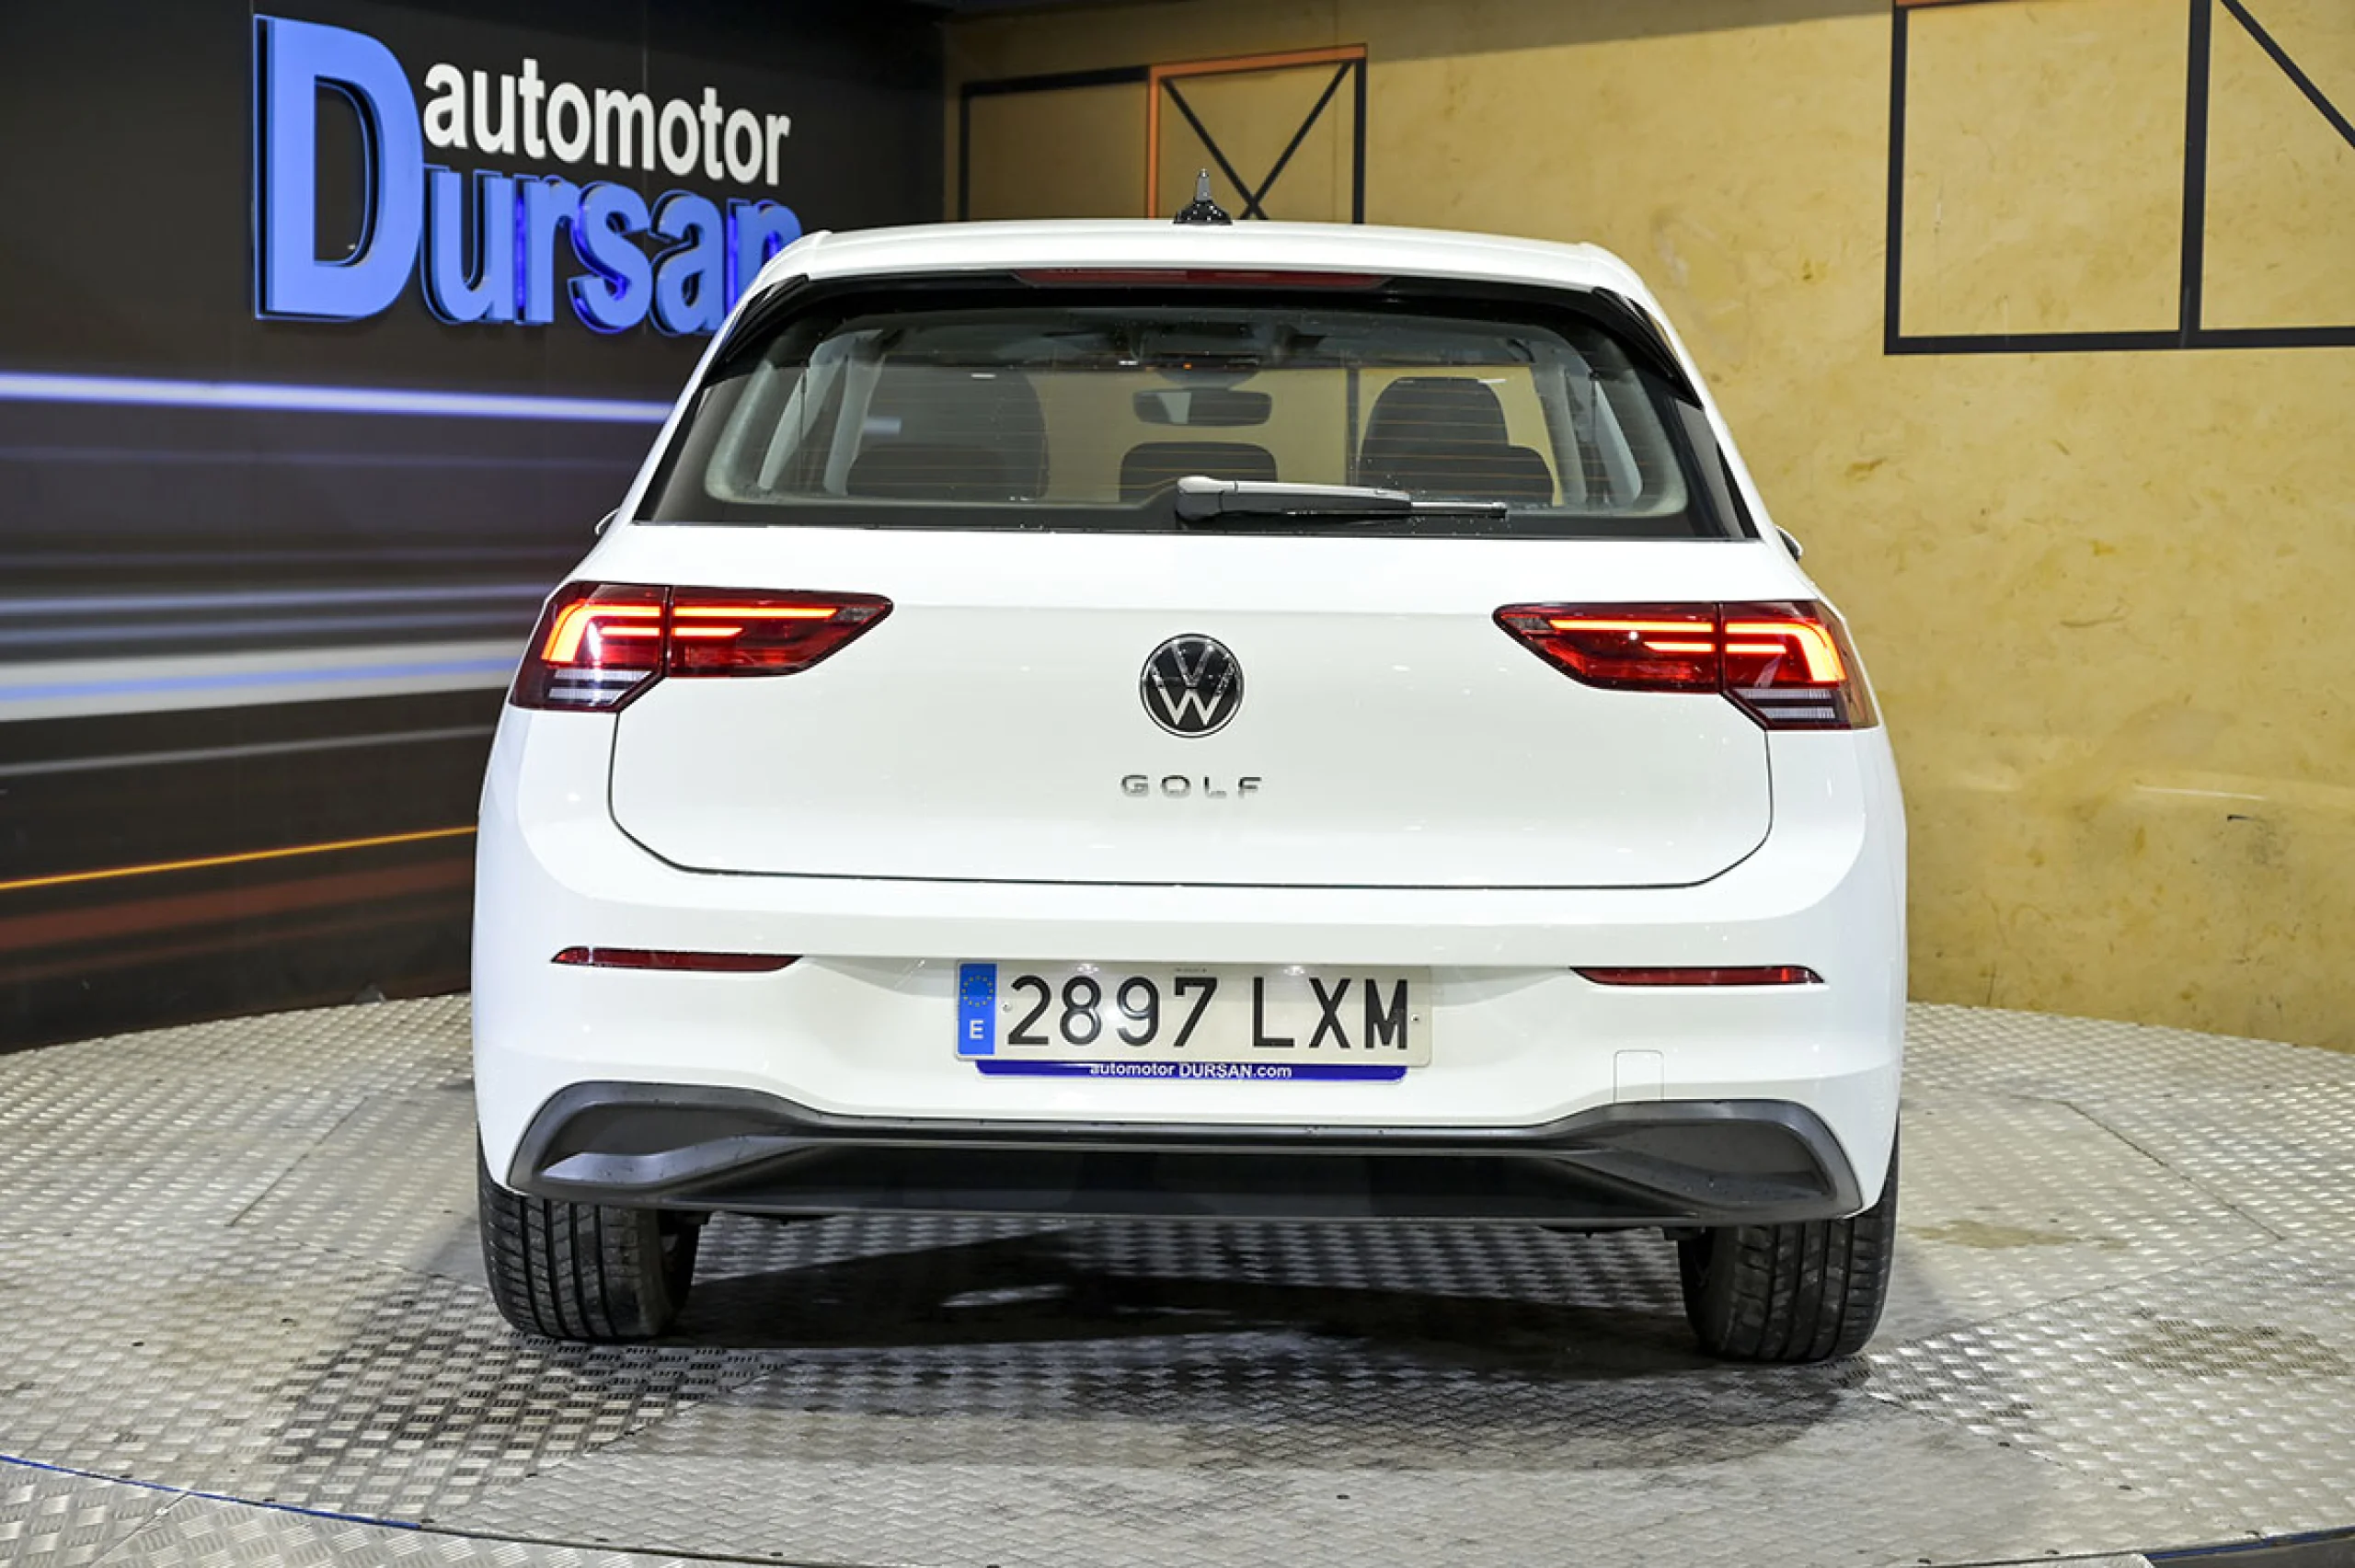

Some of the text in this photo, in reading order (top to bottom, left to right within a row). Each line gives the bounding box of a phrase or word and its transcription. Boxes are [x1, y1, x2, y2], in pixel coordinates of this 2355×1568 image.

[423, 57, 790, 186] automotor
[253, 13, 802, 337] Dursan
[1120, 774, 1262, 798] GOLF
[969, 1019, 984, 1040] E
[1006, 975, 1408, 1049] 2897 LXM
[1089, 1062, 1292, 1079] automotor DURSAN.com
